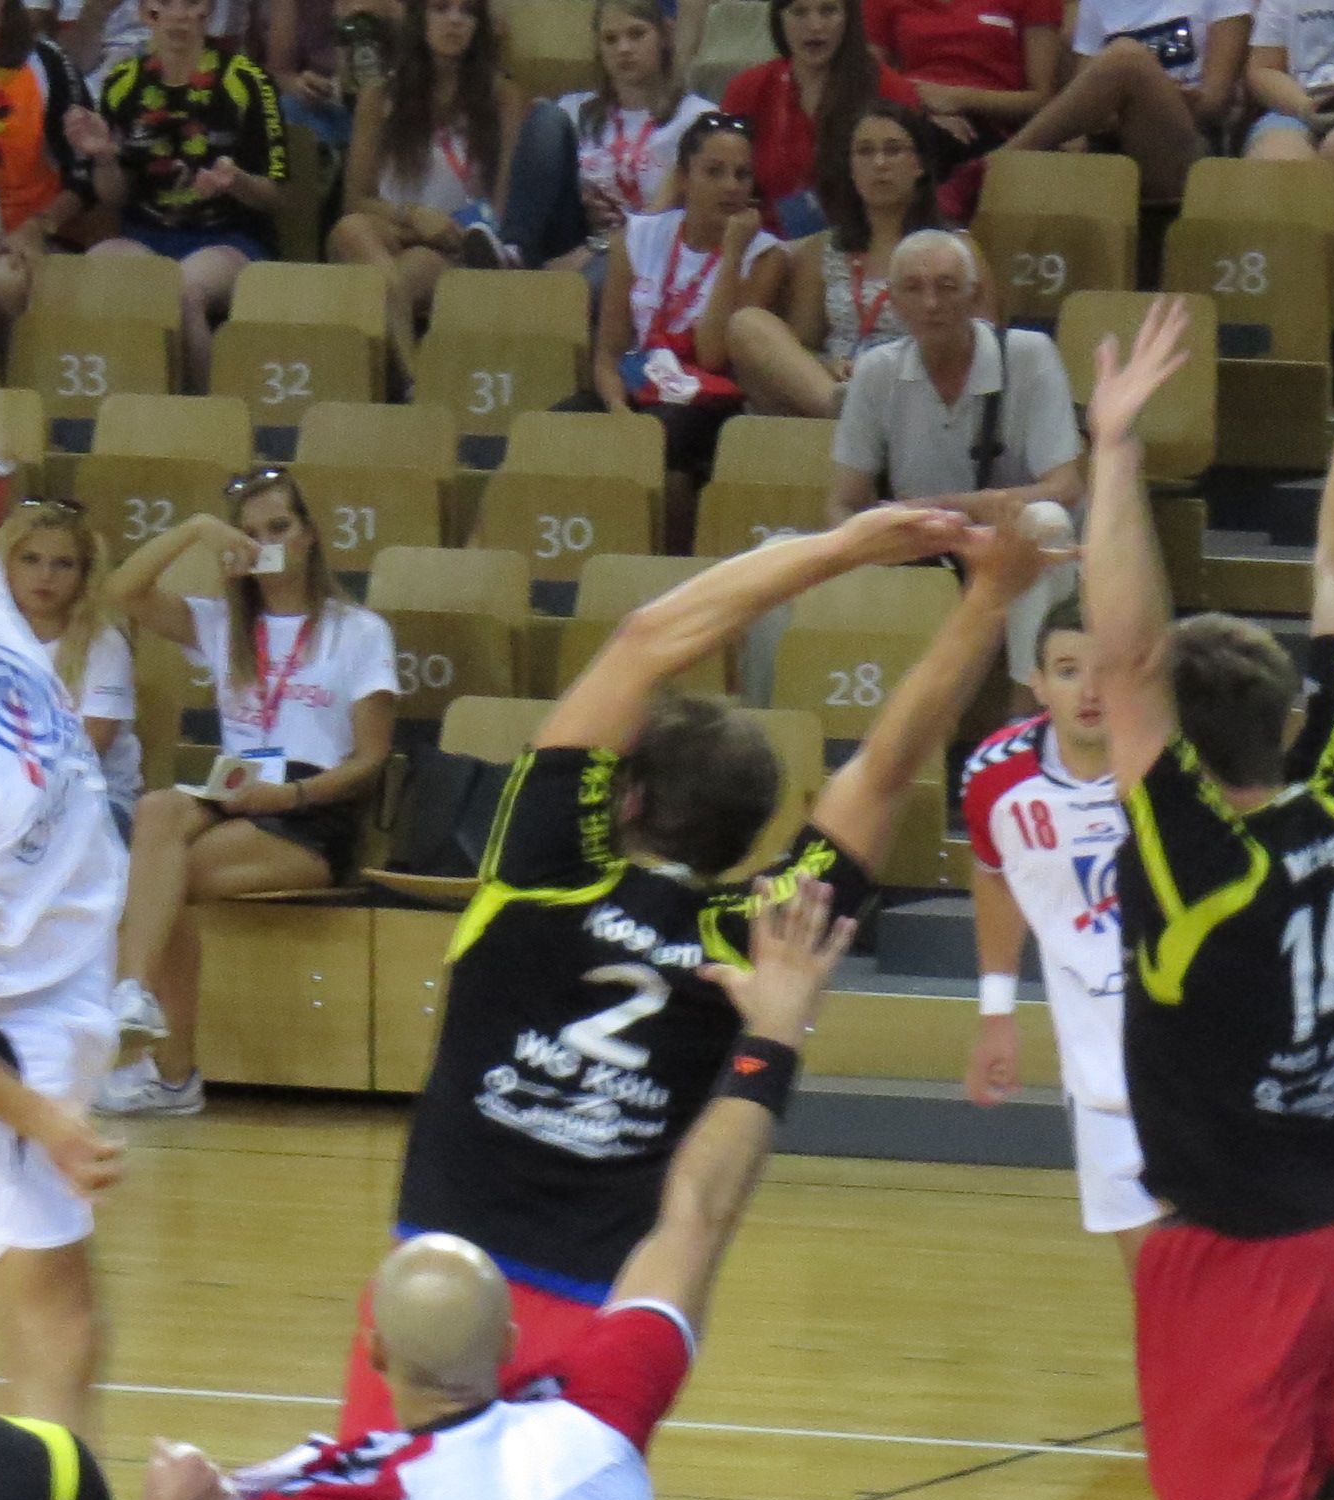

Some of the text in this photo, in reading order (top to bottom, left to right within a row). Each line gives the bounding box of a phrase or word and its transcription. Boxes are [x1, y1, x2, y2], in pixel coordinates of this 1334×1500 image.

[1011, 252, 1067, 296] 29
[1212, 251, 1267, 295] 28
[58, 354, 107, 398] 33
[262, 362, 313, 404] 32
[470, 369, 513, 415] 31
[123, 498, 173, 541] 32
[332, 506, 375, 550] 31
[536, 514, 595, 560] 30
[824, 662, 883, 707] 28
[1010, 799, 1058, 850] 18
[559, 962, 673, 1070] 2
